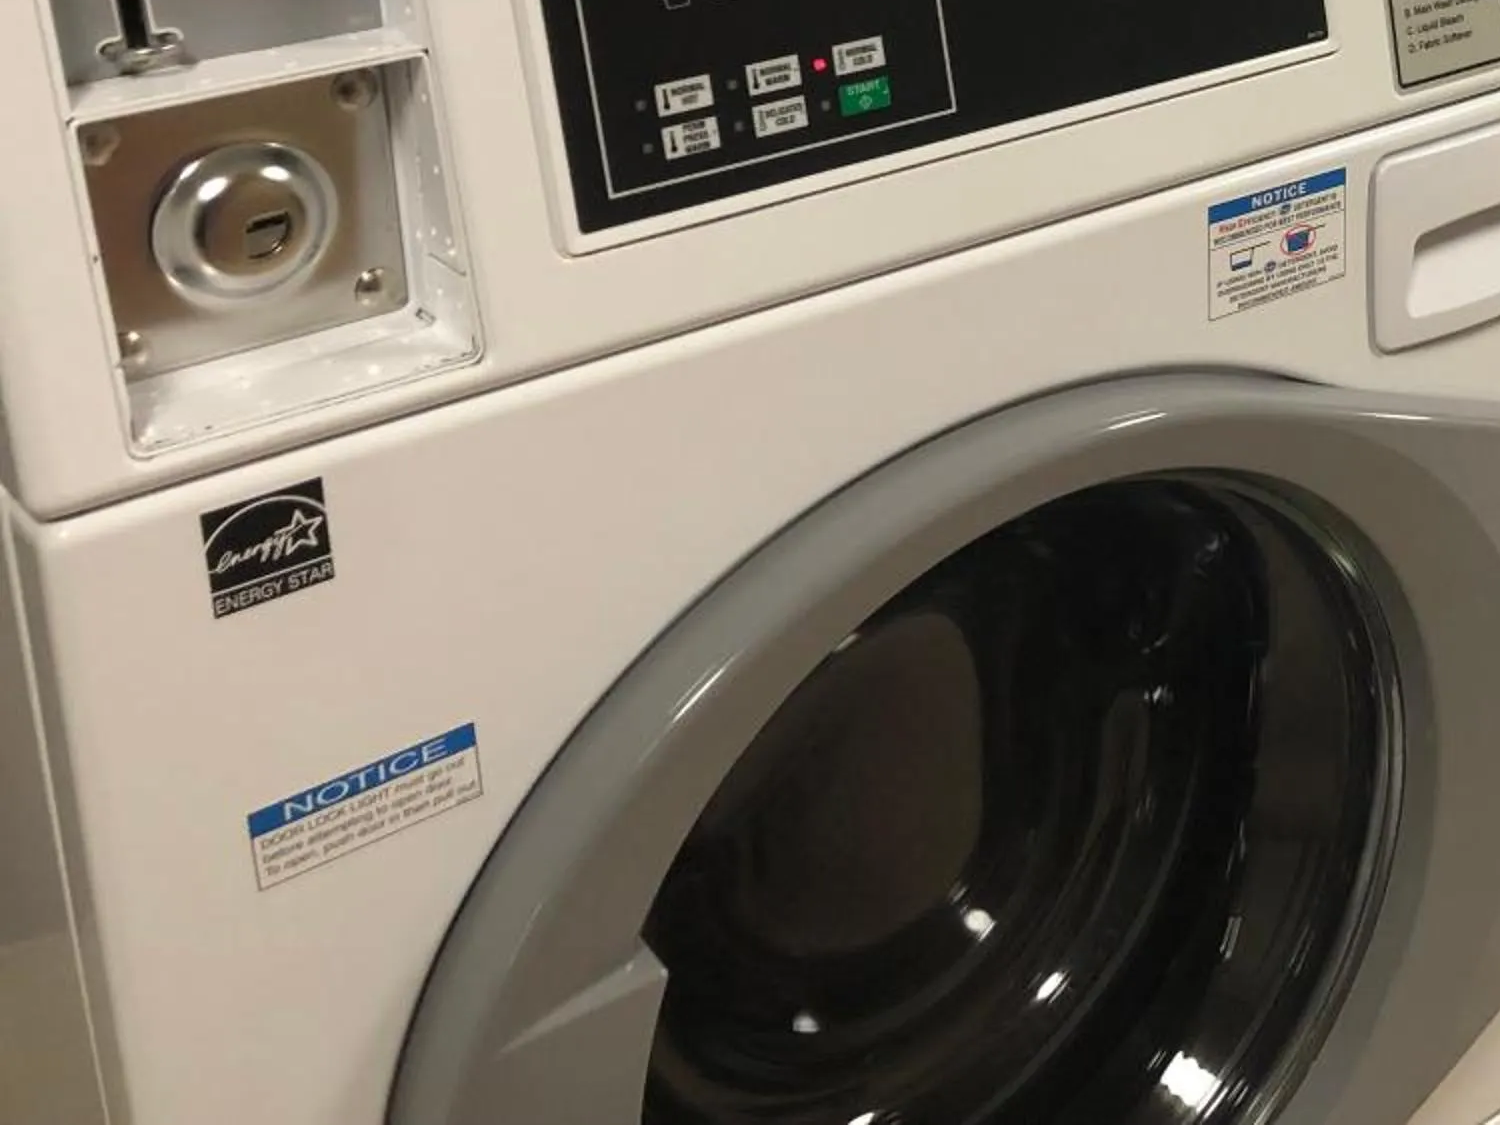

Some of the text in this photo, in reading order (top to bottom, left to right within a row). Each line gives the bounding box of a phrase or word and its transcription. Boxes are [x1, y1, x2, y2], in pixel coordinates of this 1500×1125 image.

[847, 78, 880, 96] START
[1251, 181, 1308, 209] NOTICE
[215, 560, 334, 615] ENERGY STAR
[284, 737, 448, 822] NOTICE
[260, 822, 304, 850] DOOR
[307, 808, 344, 831] LOCK
[348, 787, 389, 811] LIGHT
